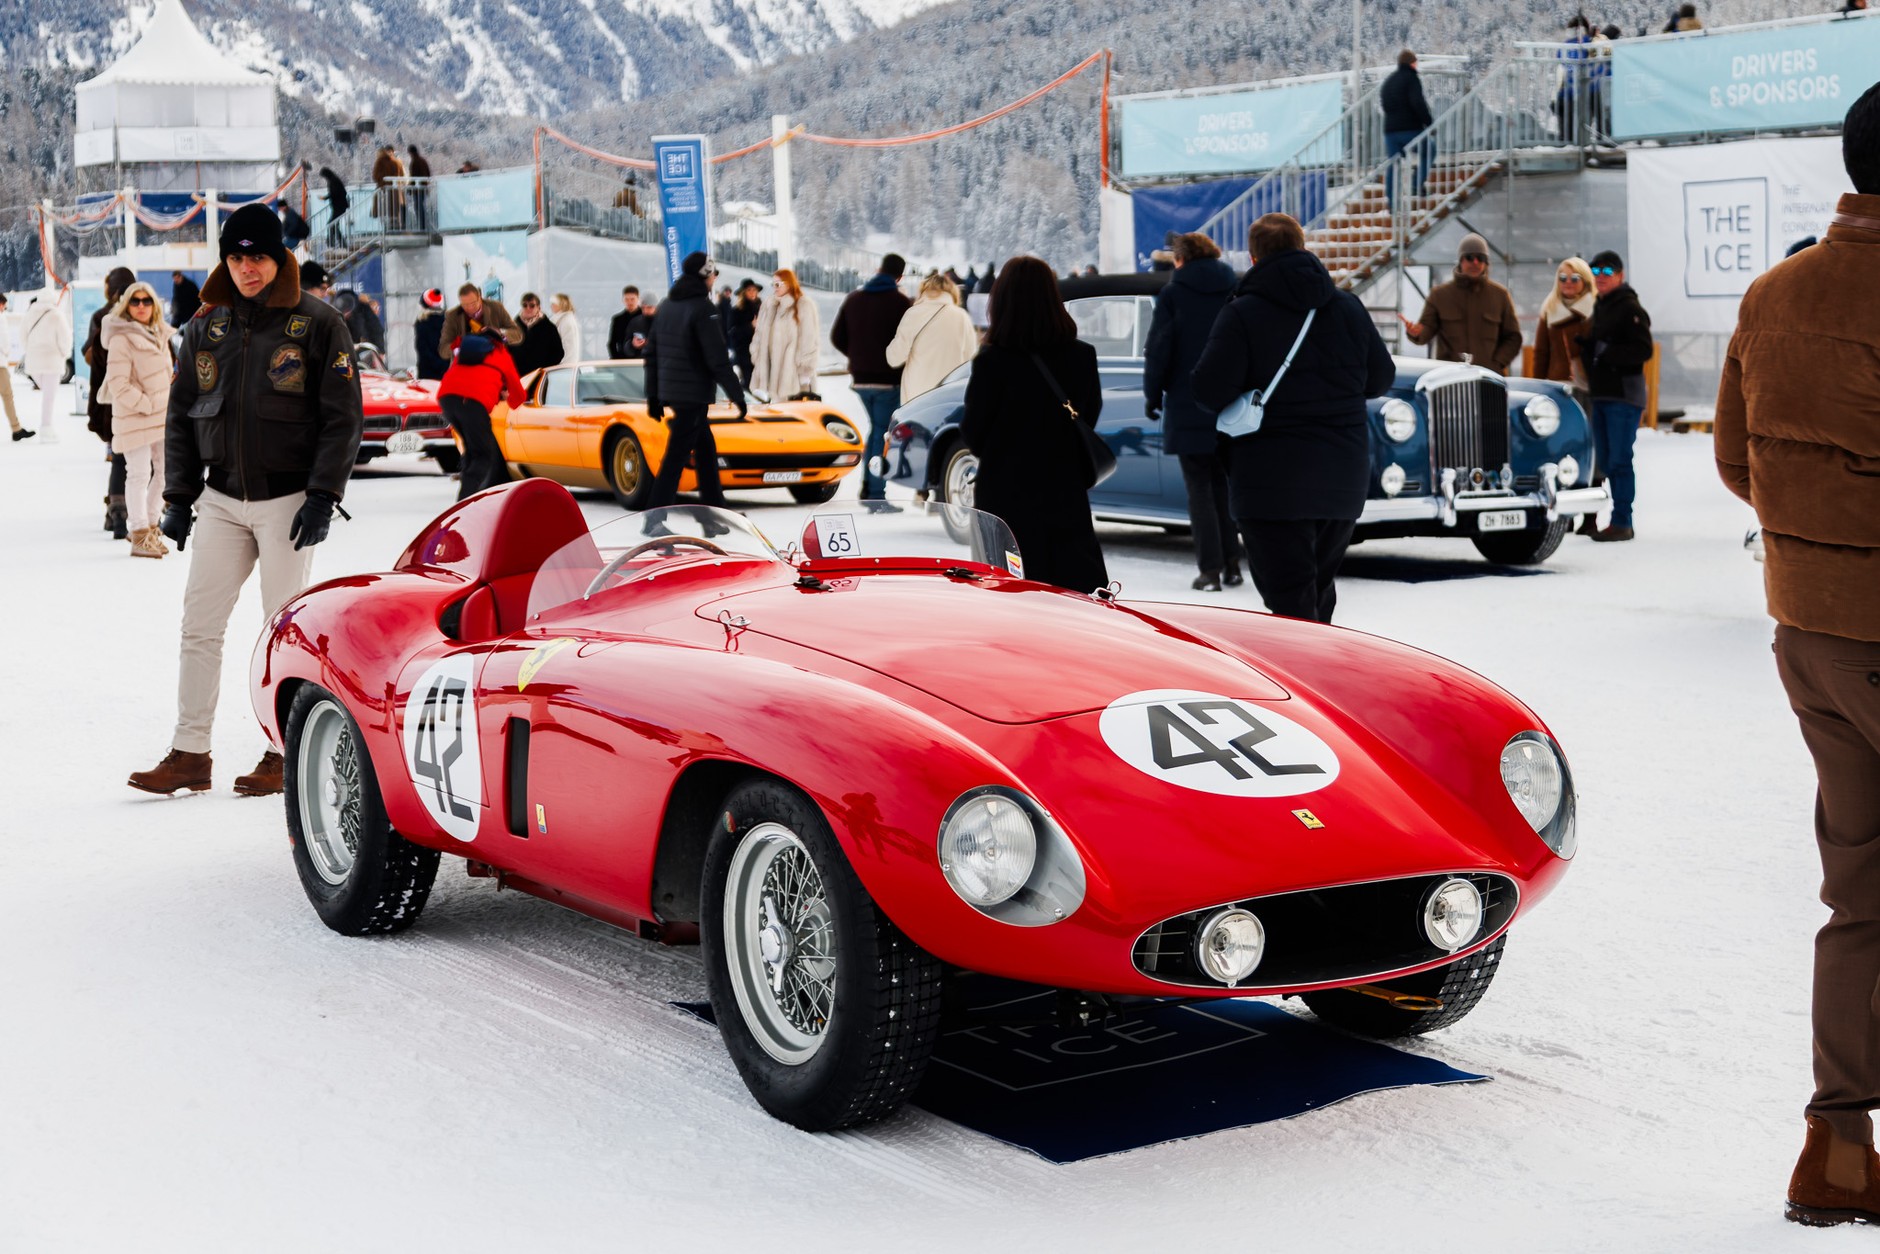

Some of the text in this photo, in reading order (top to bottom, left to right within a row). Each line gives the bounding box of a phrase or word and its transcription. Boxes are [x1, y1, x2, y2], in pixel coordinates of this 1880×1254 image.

[1731, 48, 1818, 79] DRIVERS
[1709, 74, 1841, 109] & SPONSORS
[1198, 111, 1254, 133] DRIVERS
[1700, 205, 1751, 233] THE
[1704, 243, 1752, 272] ICE
[828, 532, 851, 553] 65
[414, 674, 475, 823] 42
[1146, 701, 1327, 780] 42
[1012, 1019, 1179, 1063] ICE
